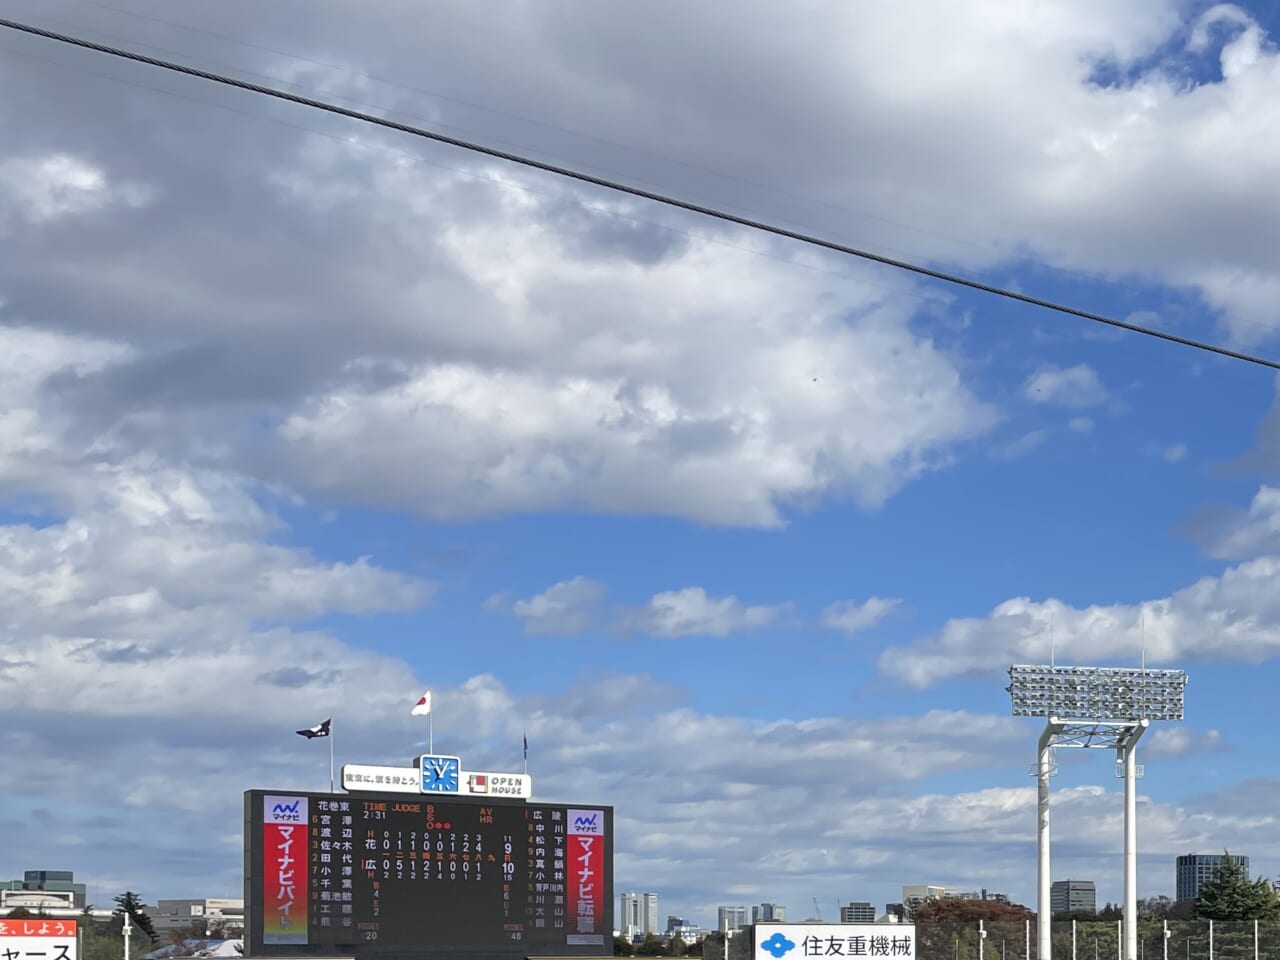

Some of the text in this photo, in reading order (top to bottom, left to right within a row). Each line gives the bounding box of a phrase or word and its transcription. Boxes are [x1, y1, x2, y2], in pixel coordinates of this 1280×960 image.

[491, 777, 522, 786] OPEN
[491, 786, 522, 795] HOUSE
[318, 801, 350, 812] 花巻東
[363, 803, 420, 812] TIME JUDGE
[427, 804, 434, 813] B
[272, 813, 300, 821] マイナビ
[363, 811, 386, 819] 2:31
[427, 813, 434, 821] S
[427, 821, 434, 829] O
[535, 824, 563, 833] 中川
[575, 825, 597, 833] マイナビ
[365, 839, 376, 849] 花
[535, 836, 563, 845] 松下
[535, 848, 563, 857] 内海
[365, 860, 376, 869] 広
[277, 825, 295, 929] マイナビバイト
[535, 872, 563, 881] 小林
[366, 932, 377, 940] 20
[801, 935, 912, 957] 住友重機械
